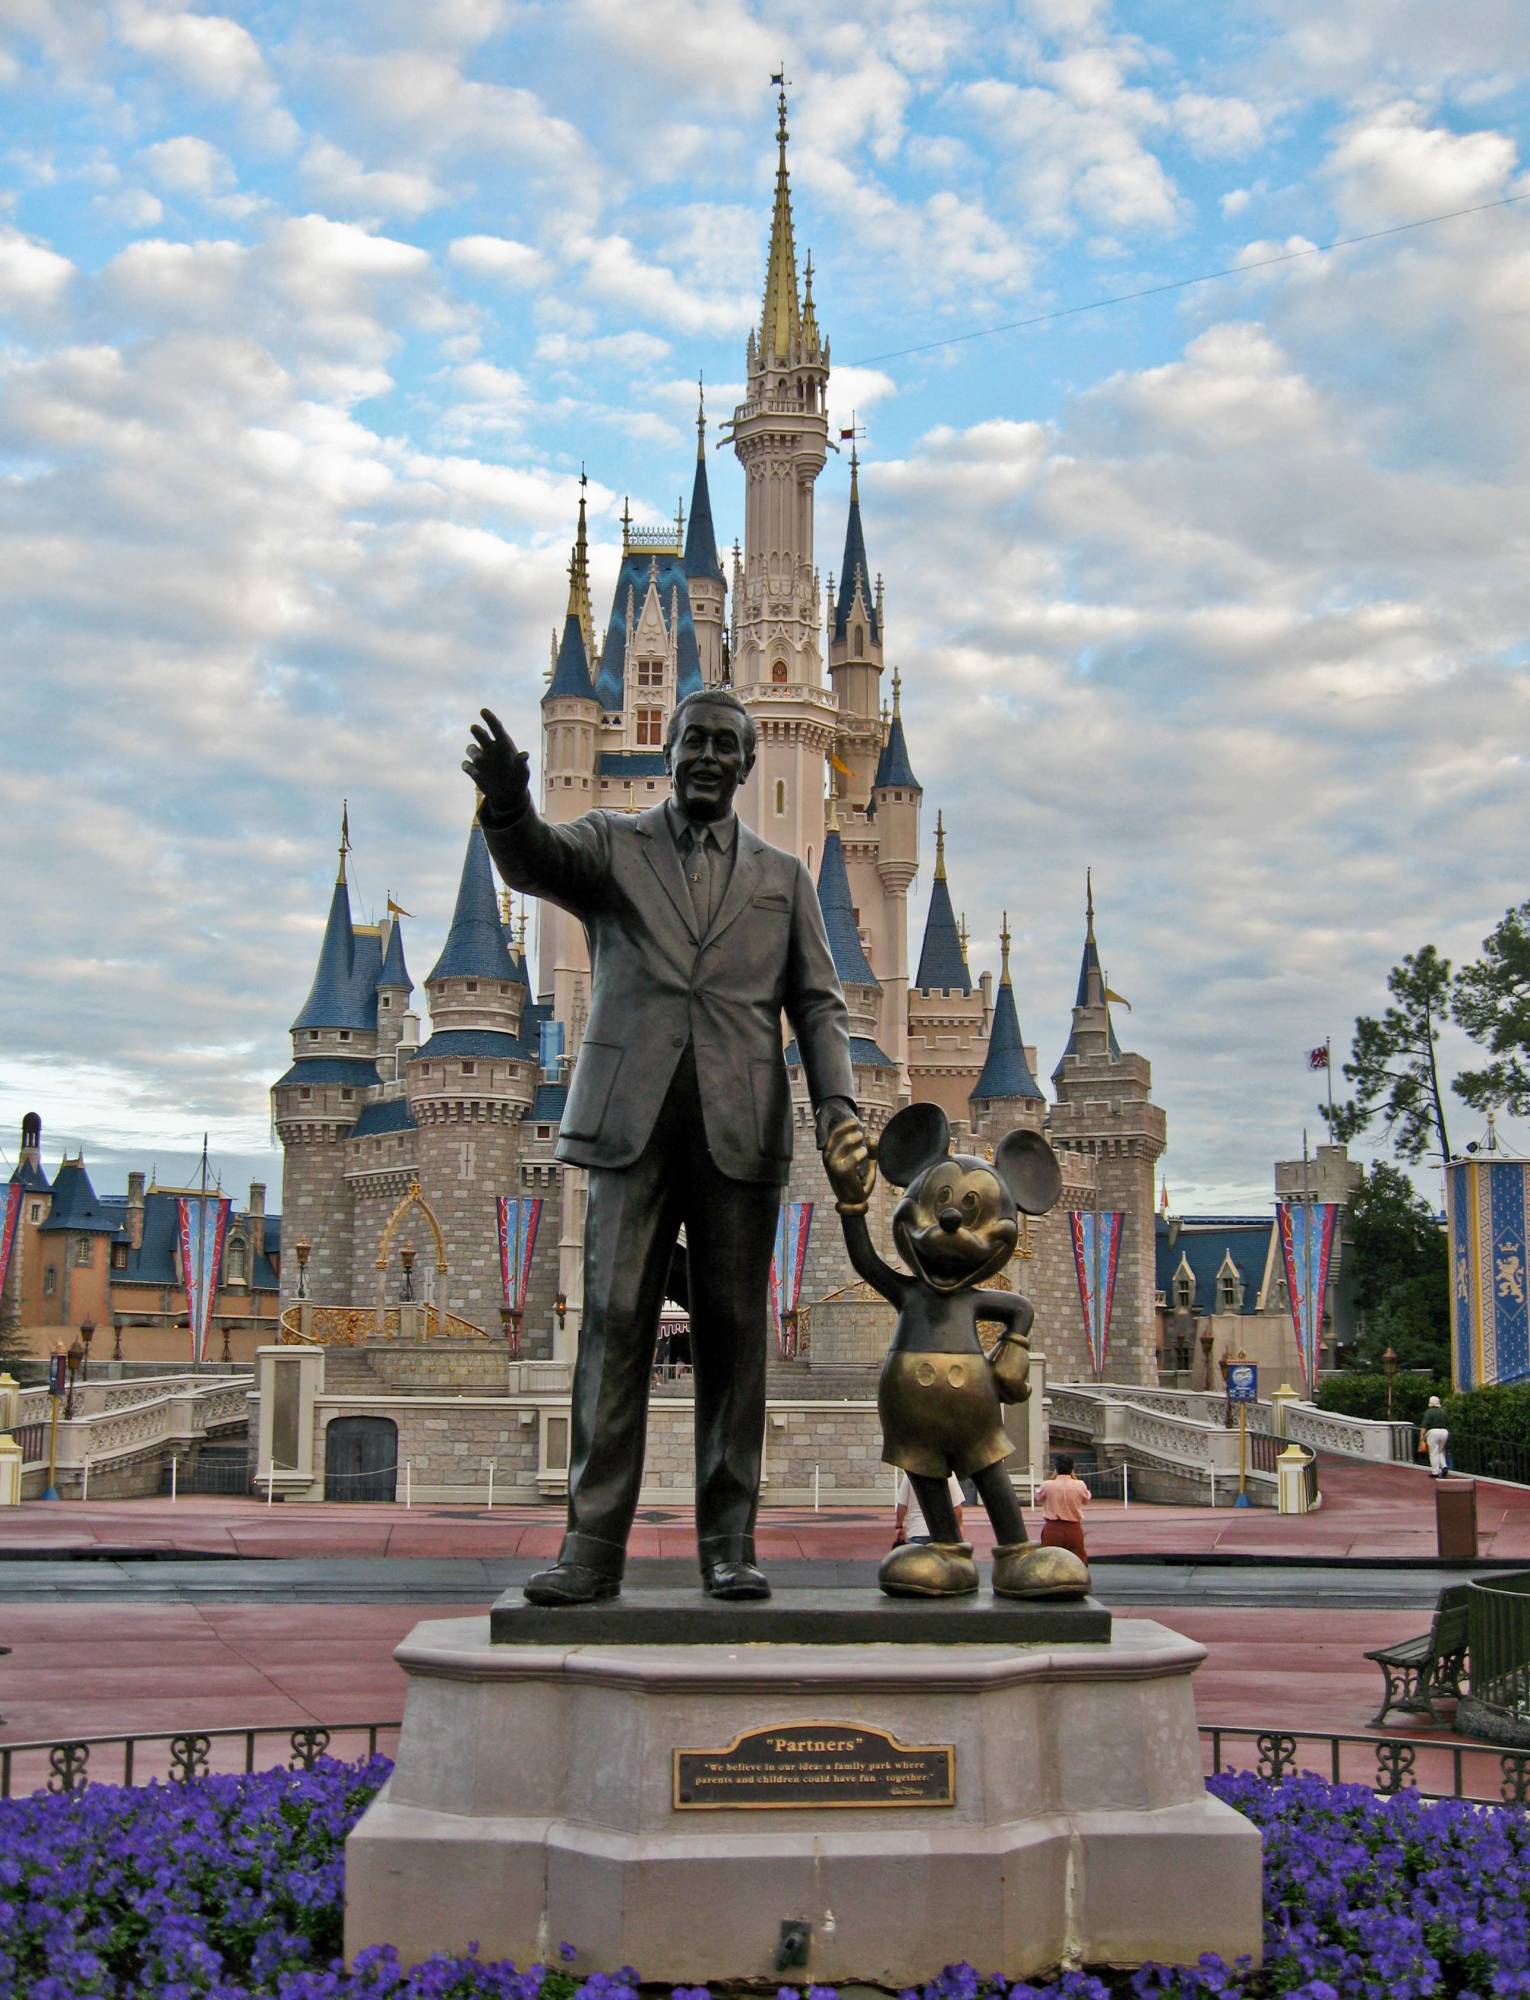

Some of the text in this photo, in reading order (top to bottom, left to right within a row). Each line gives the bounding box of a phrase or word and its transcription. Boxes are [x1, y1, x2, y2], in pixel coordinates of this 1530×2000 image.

[766, 1738, 863, 1752] "Partners"
[726, 1763, 761, 1771] believe
[765, 1763, 775, 1771] in
[834, 1762, 865, 1772] family
[869, 1761, 891, 1771] park
[894, 1761, 925, 1769] where
[695, 1777, 732, 1786] parents
[735, 1775, 754, 1783] and
[756, 1775, 801, 1783] children
[802, 1775, 830, 1783] could
[859, 1774, 876, 1782] fun
